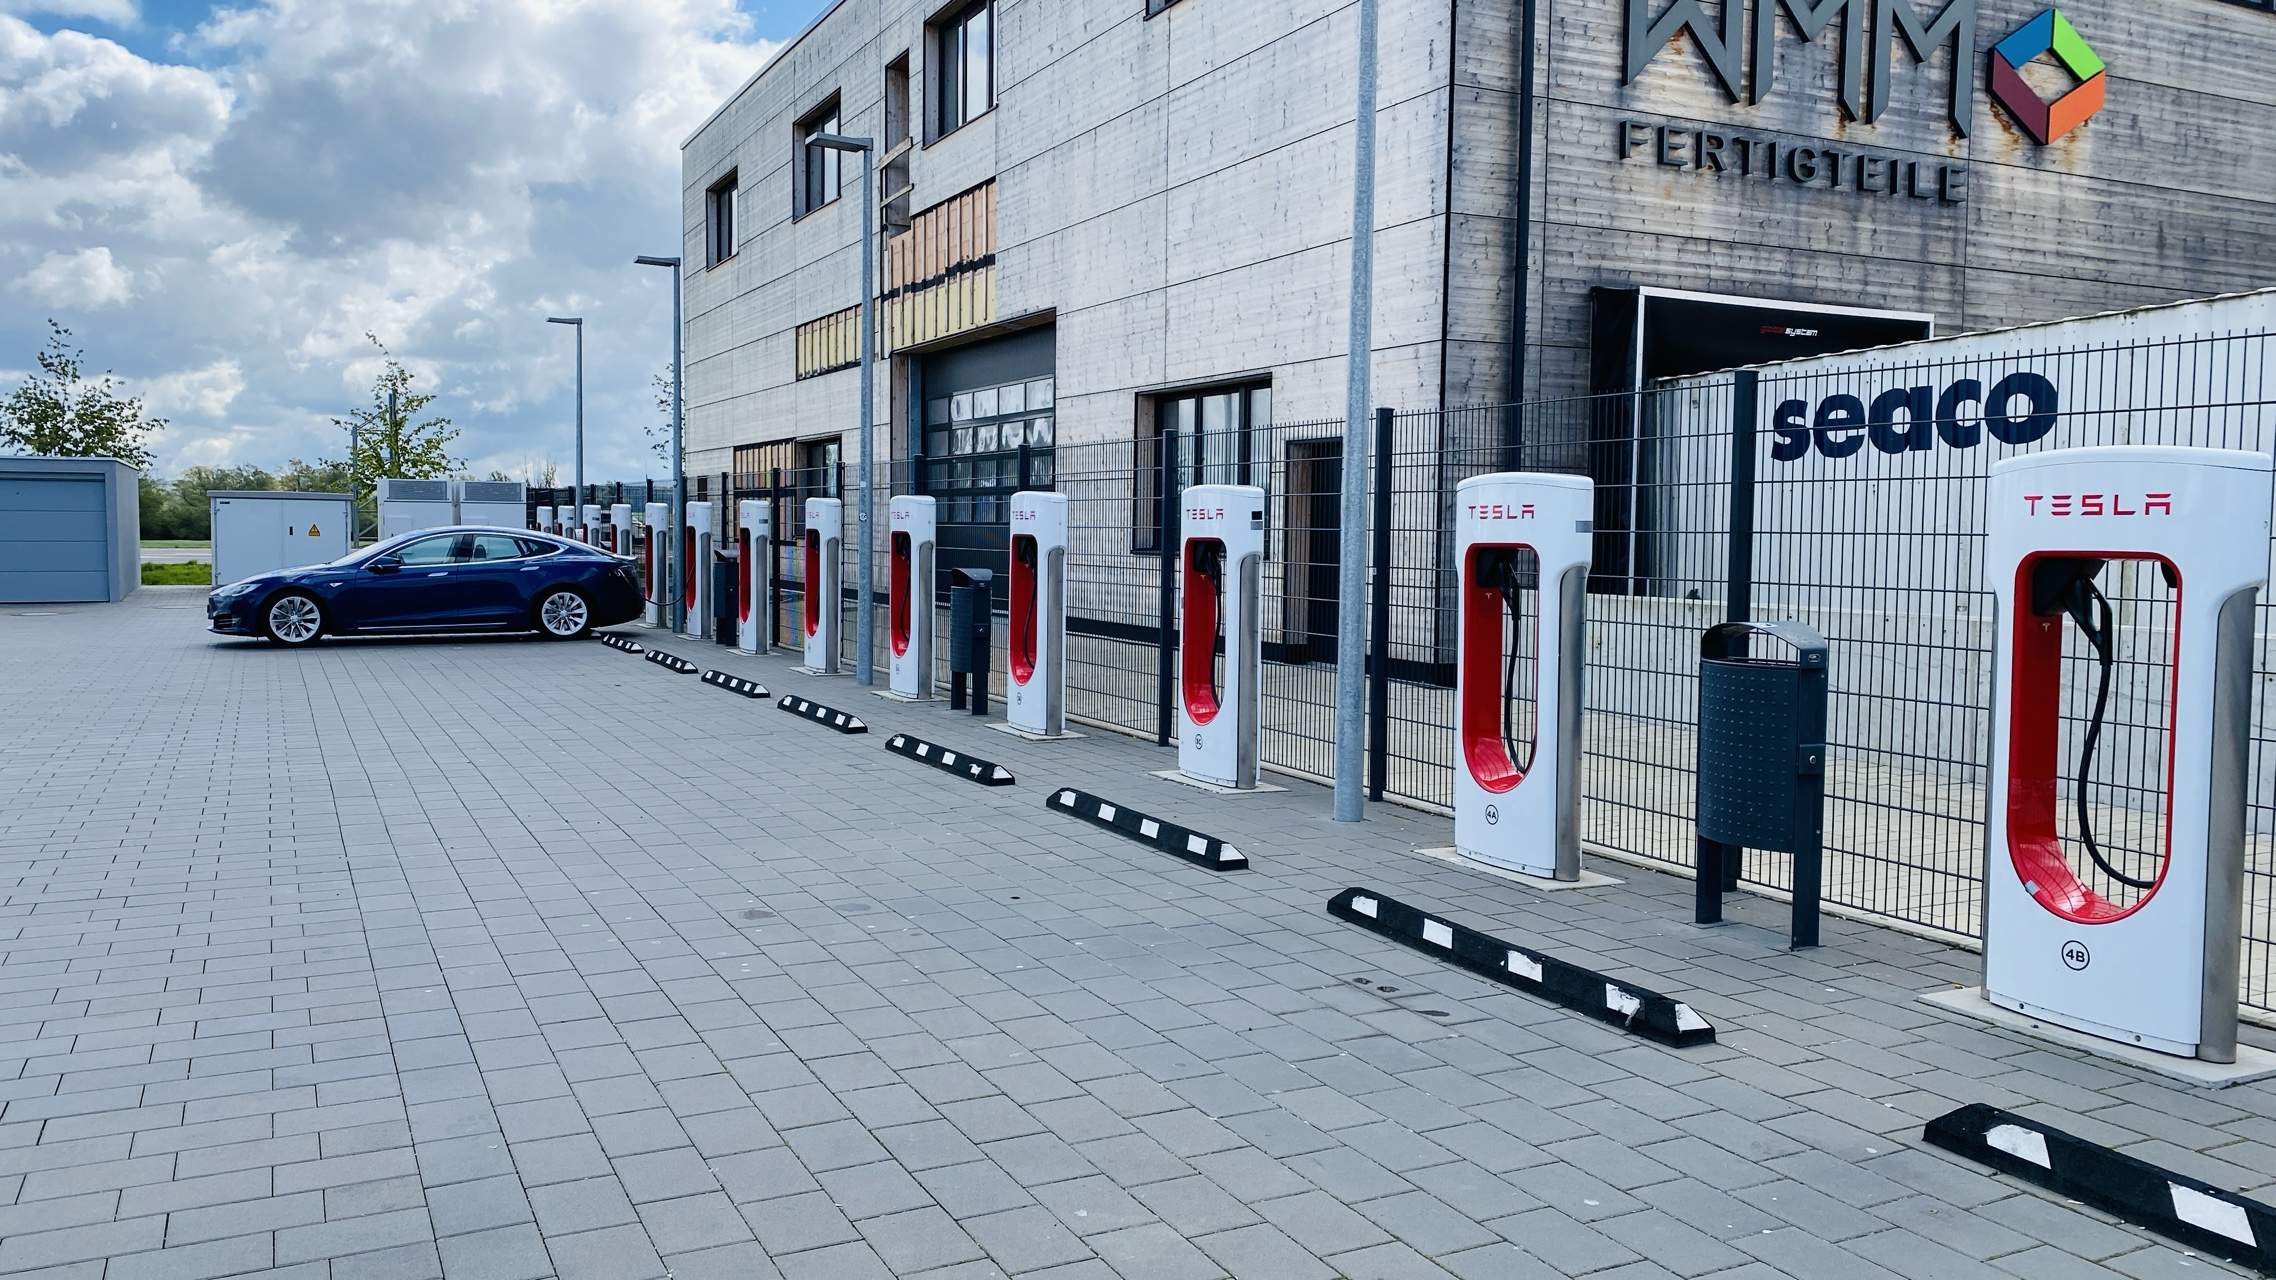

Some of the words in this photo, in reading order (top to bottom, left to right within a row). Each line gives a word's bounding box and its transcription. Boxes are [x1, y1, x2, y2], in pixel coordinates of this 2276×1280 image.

[1619, 119, 1968, 202] FERTIGTEILE
[1771, 372, 2058, 461] seaco
[1186, 508, 1224, 520] TESLA
[1468, 504, 1535, 520] TESLA
[2023, 493, 2172, 516] TESLA
[2065, 948, 2086, 963] 4B
